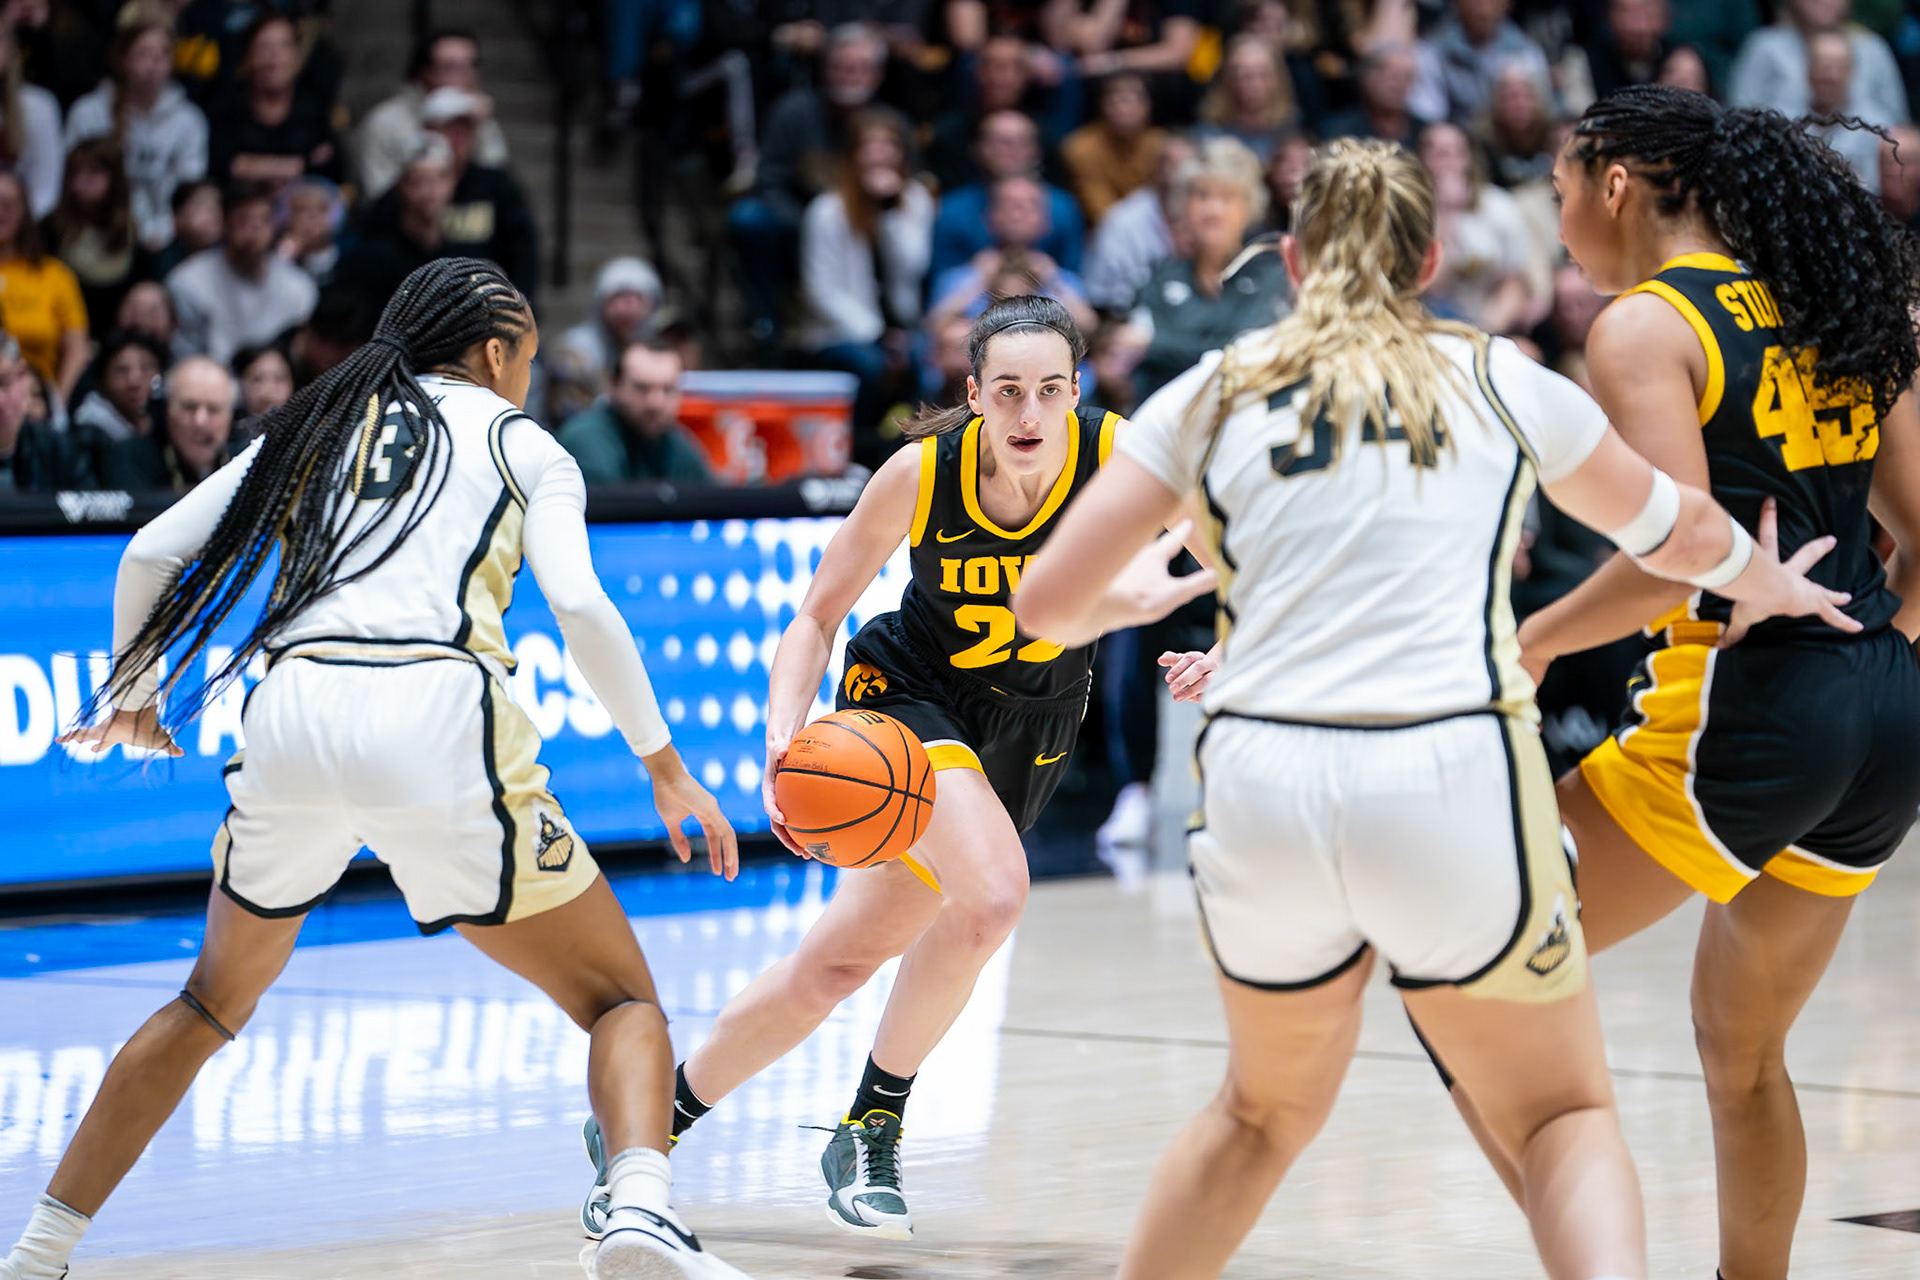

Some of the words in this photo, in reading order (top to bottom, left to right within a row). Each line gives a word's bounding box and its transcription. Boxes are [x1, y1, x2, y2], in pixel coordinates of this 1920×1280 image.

[1715, 280, 1784, 332] STU
[1266, 375, 1446, 478] 34
[1752, 345, 1880, 472] 45
[347, 409, 424, 502] 3
[940, 555, 1041, 595] IOW
[950, 603, 1067, 669] 2
